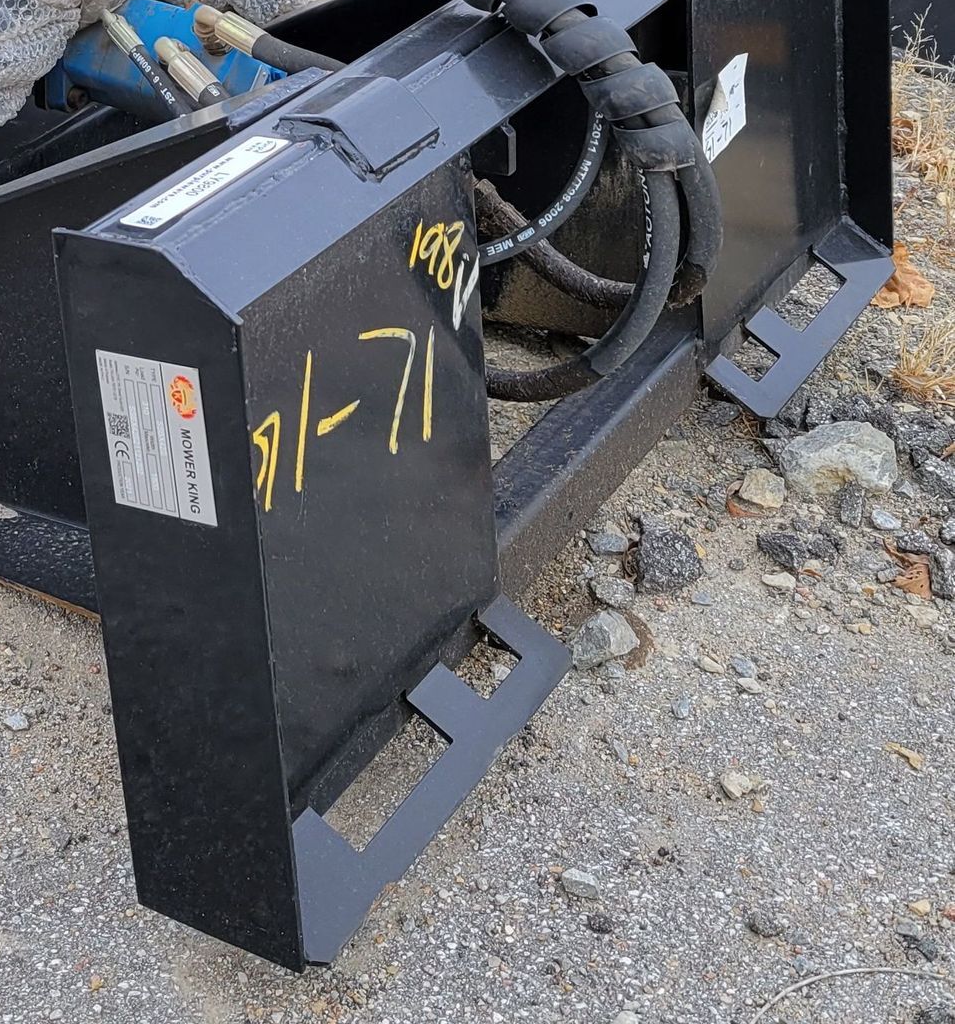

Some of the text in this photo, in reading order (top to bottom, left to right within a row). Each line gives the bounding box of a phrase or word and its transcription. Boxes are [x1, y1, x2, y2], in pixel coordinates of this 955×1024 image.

[160, 87, 176, 104] 2ST
[538, 159, 592, 227] MT/T98-2006
[486, 238, 515, 257] MEE
[180, 427, 200, 515] MOWER KING
